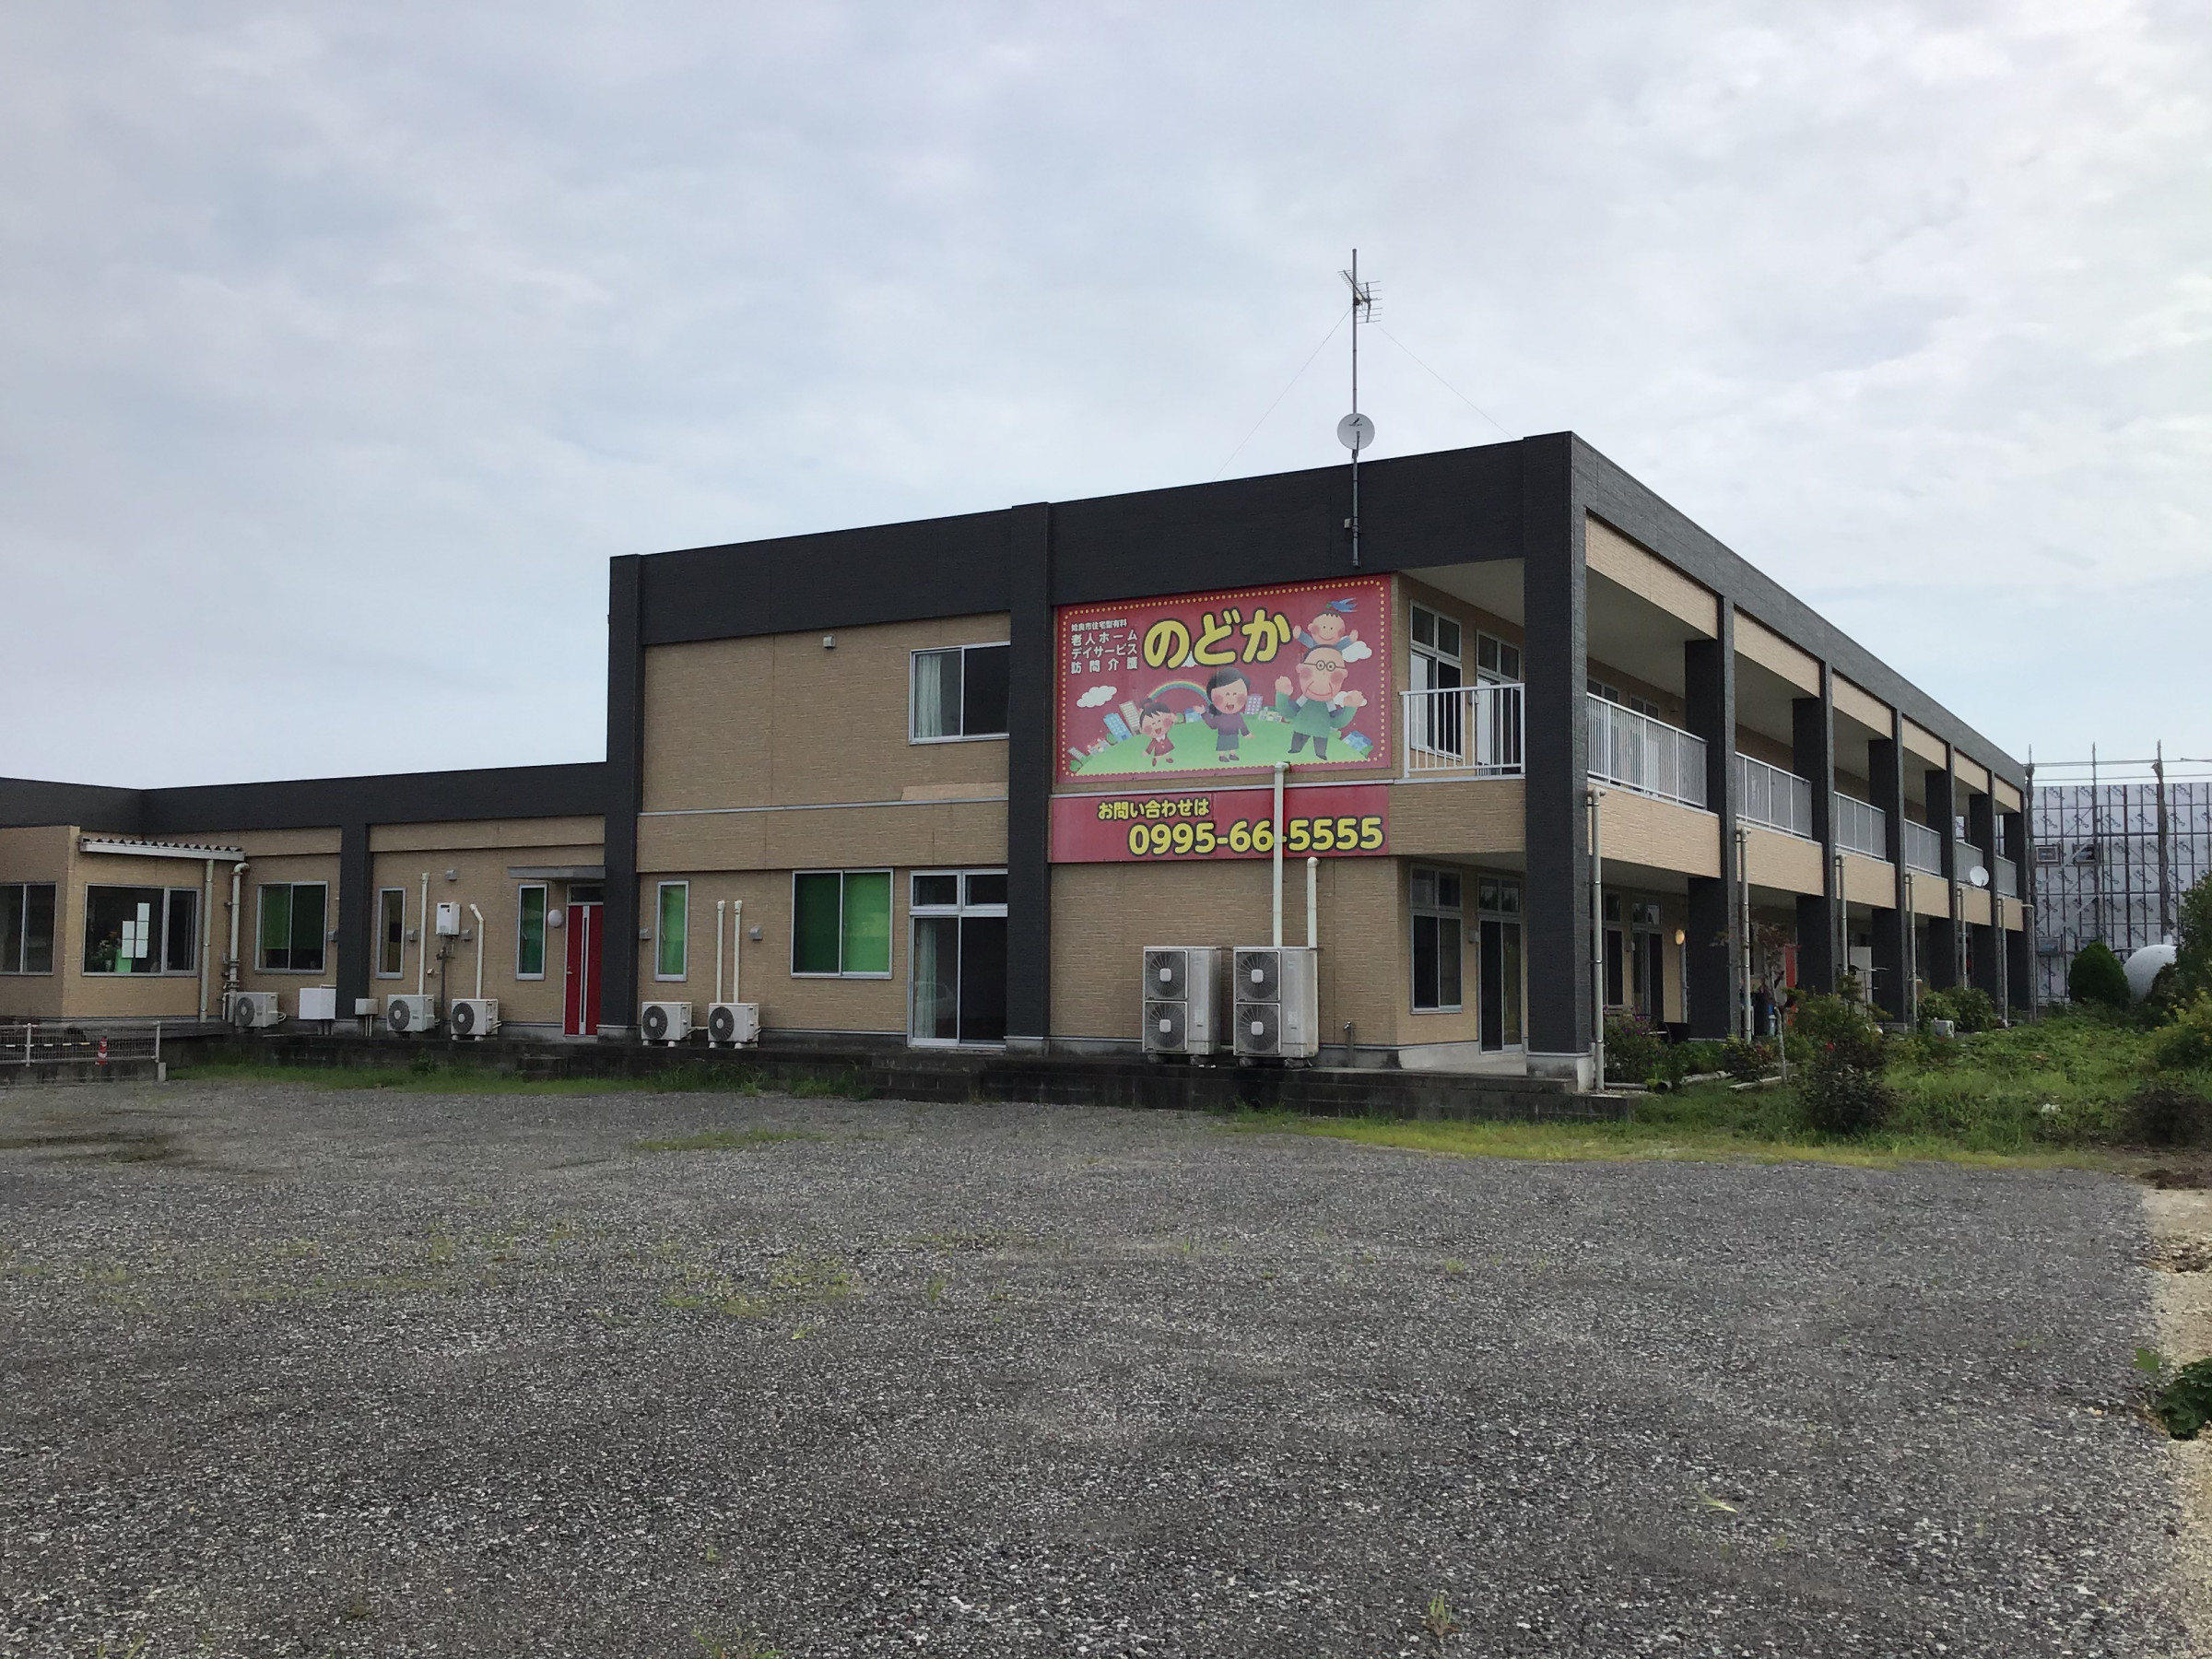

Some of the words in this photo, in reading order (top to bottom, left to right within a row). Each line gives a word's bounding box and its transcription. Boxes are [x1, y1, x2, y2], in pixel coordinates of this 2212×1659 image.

[1071, 629, 1137, 646] 老人ホーム
[1143, 608, 1291, 669] のどか
[1071, 643, 1137, 660] デイサービス
[1071, 656, 1137, 674] 訪問介護
[1098, 798, 1210, 820] お問い合わせは
